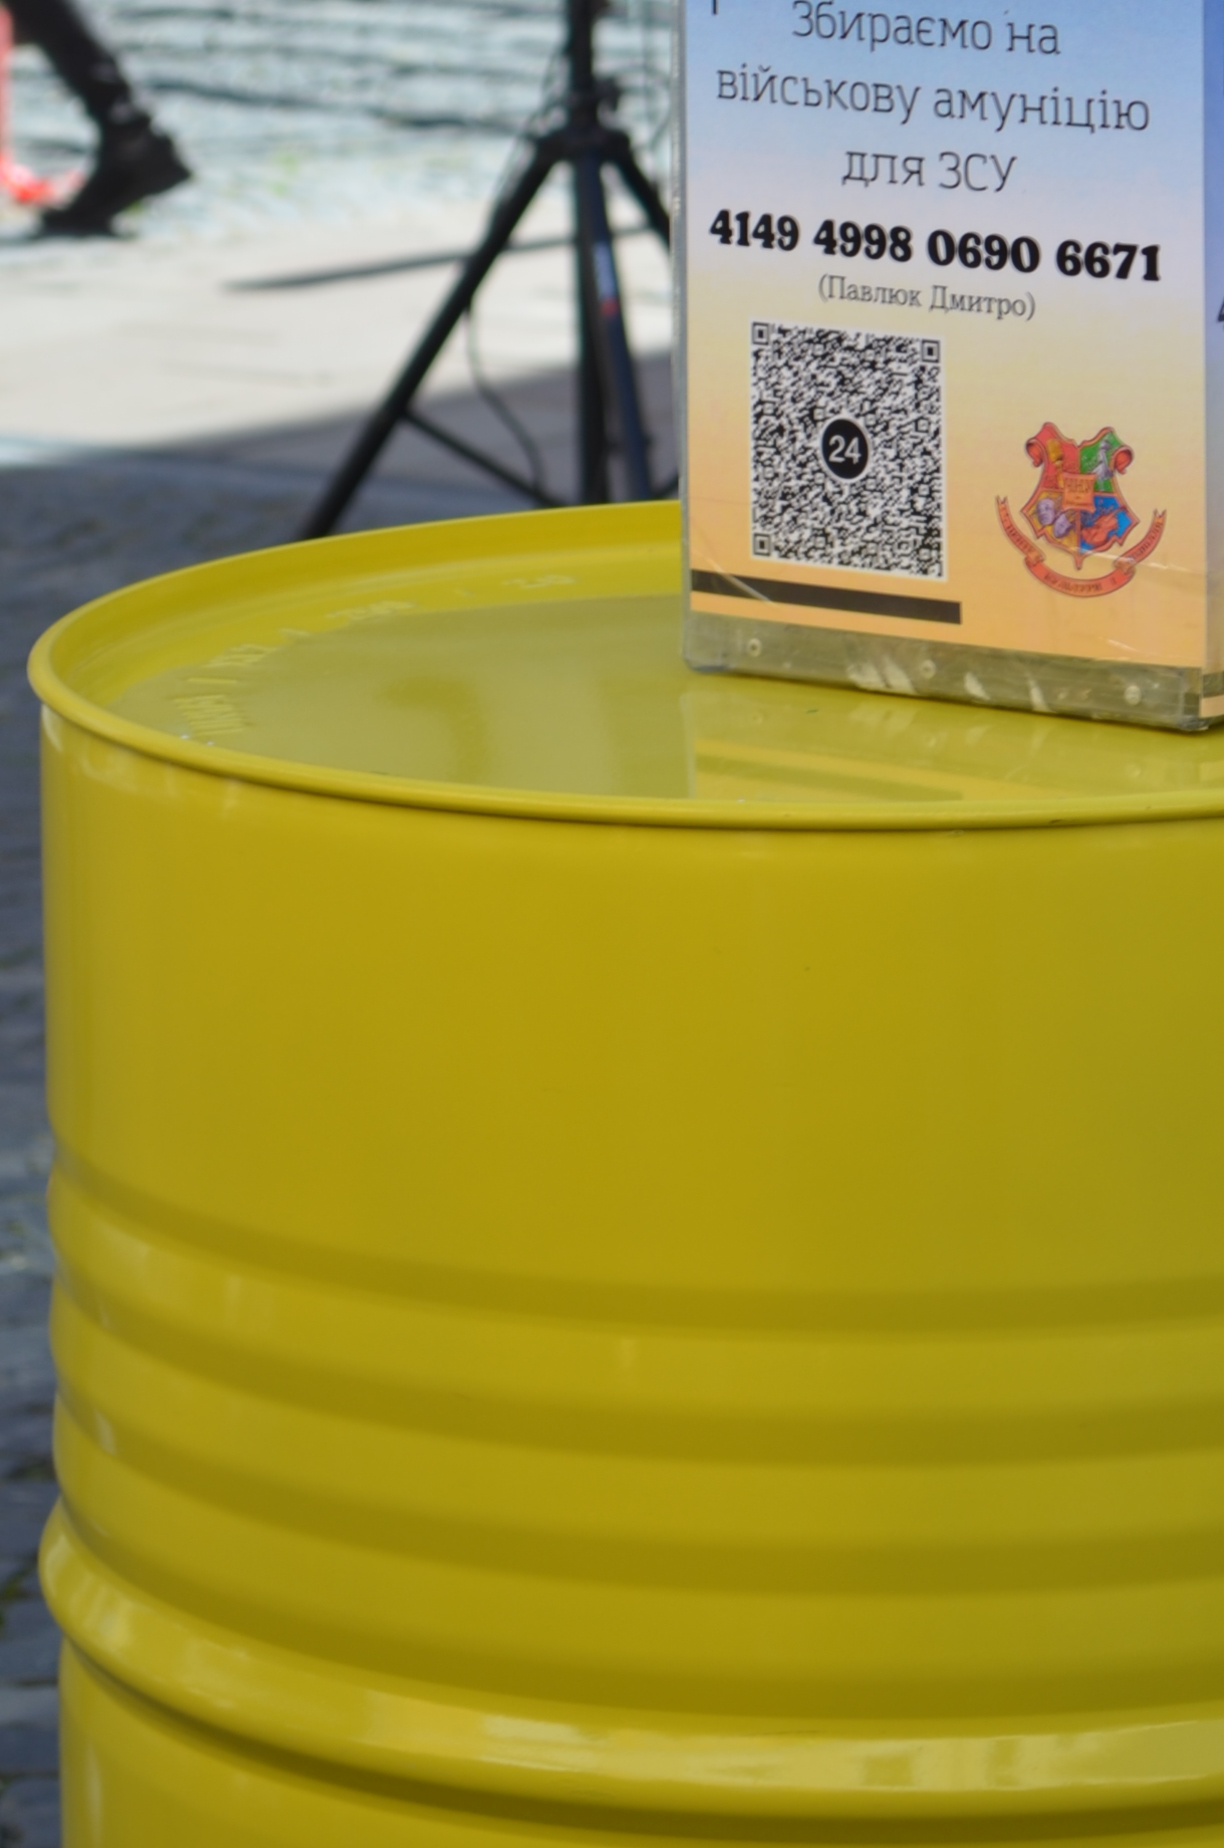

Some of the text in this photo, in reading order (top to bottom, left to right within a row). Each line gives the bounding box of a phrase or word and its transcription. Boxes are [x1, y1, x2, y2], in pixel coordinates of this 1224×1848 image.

[1007, 20, 1061, 55] на
[716, 63, 1149, 134] військову амуніцію
[841, 150, 1017, 192] для ЗСУ
[709, 208, 1161, 281] 4149 4998 0690 6671
[817, 273, 1036, 321] (Павлюк Дмитро)
[828, 434, 862, 465] 24
